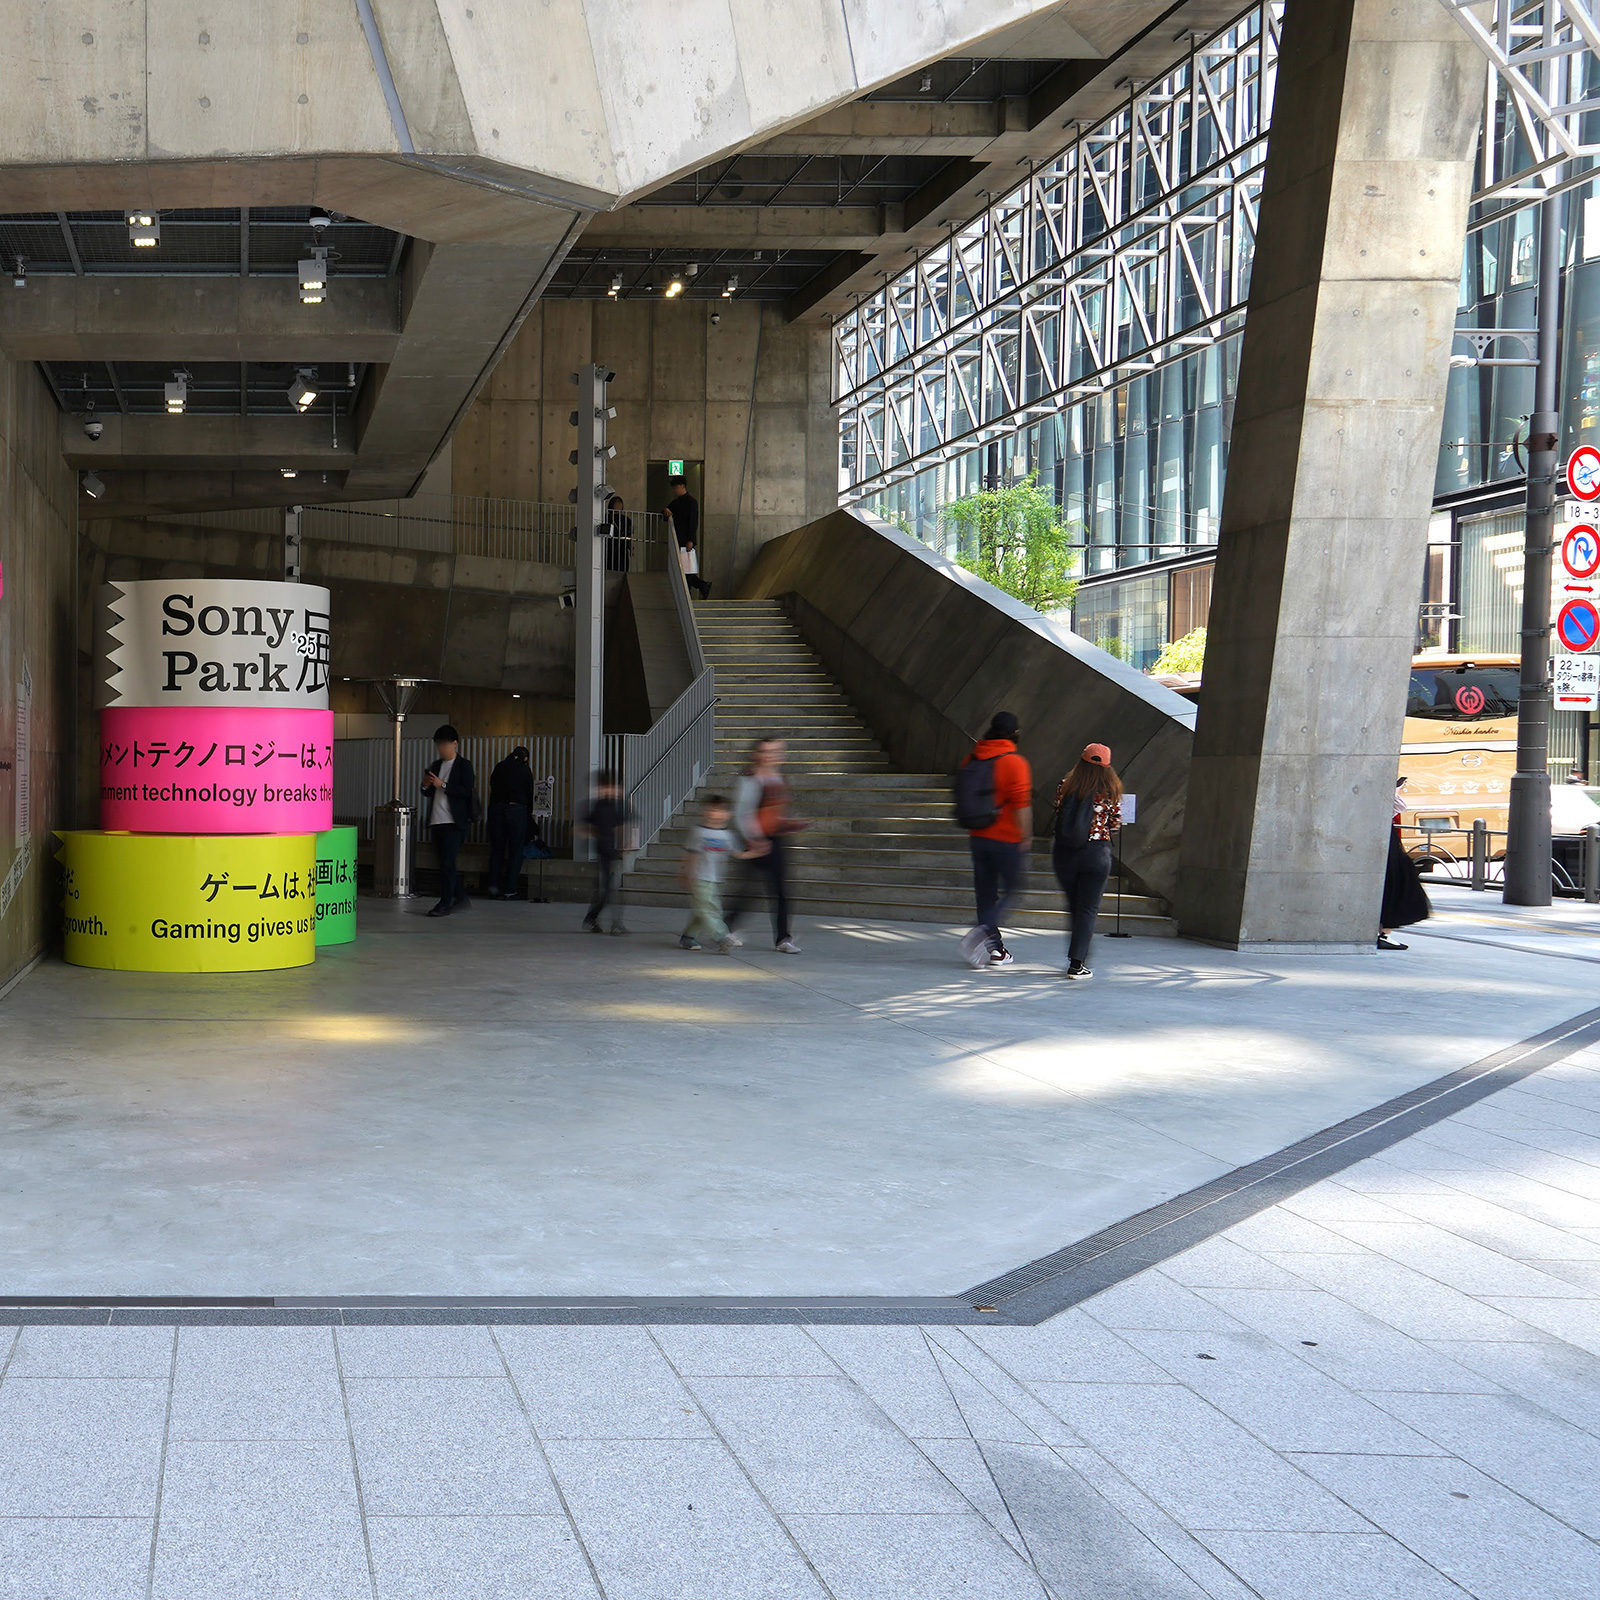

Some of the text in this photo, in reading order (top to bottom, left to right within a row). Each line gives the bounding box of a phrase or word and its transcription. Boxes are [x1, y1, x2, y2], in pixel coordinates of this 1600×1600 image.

[162, 594, 294, 649] Sony
[162, 651, 290, 692] Park
[142, 783, 257, 807] technology
[263, 783, 317, 802] breaks
[151, 918, 241, 943] Gaming
[247, 917, 293, 943] gives
[296, 917, 309, 934] us
